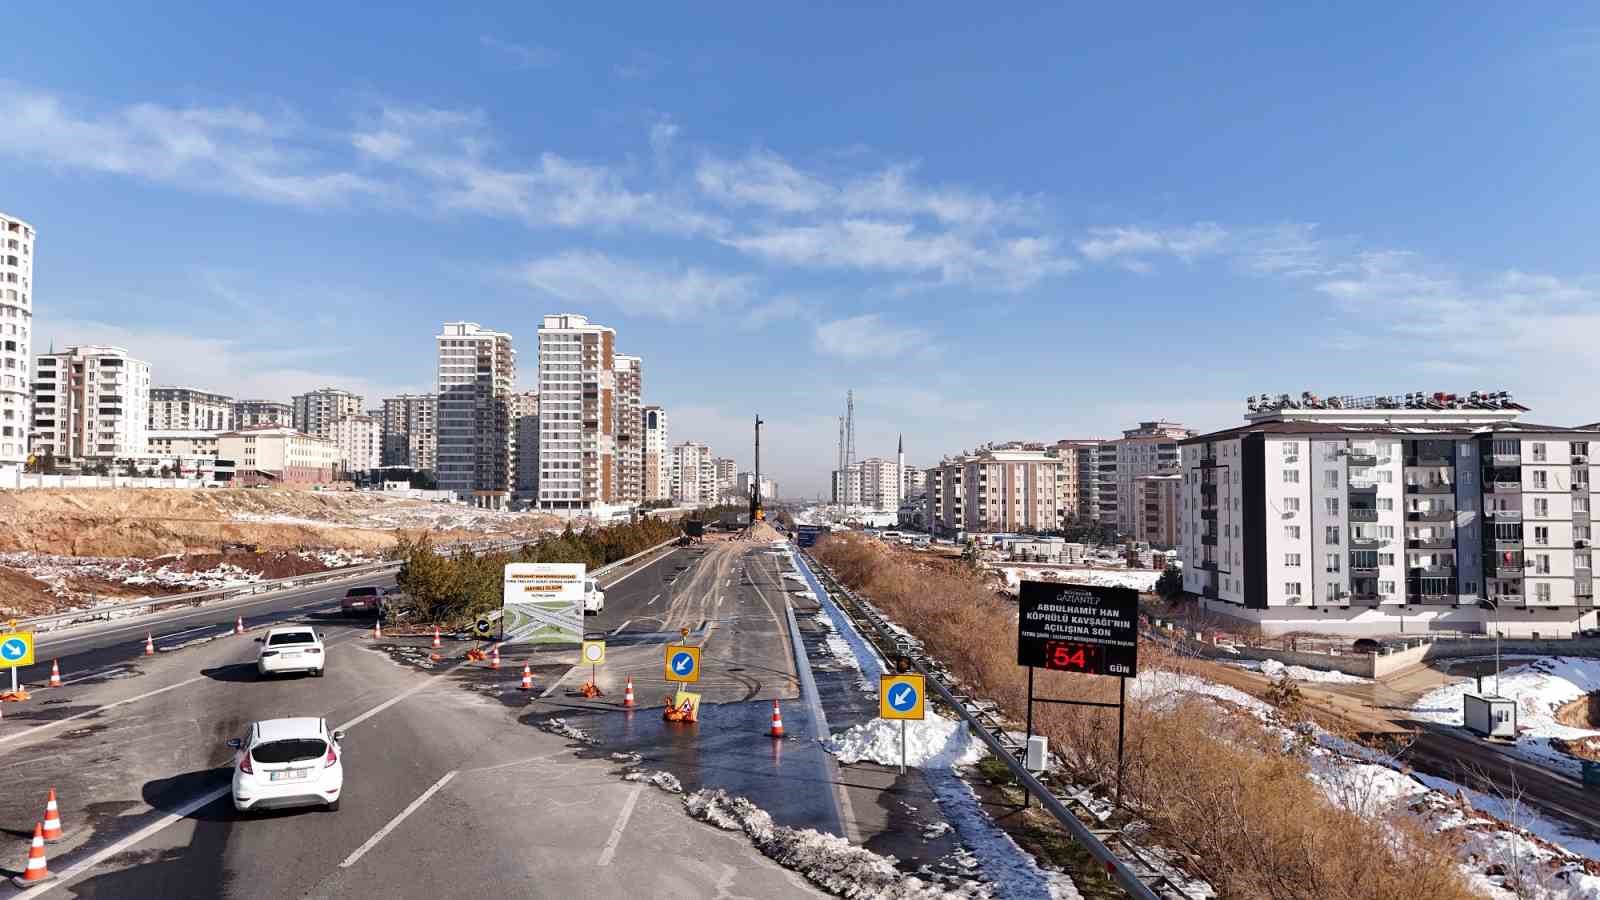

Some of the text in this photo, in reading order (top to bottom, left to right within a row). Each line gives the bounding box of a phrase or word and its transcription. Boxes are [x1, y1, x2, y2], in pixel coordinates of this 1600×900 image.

[1037, 603, 1120, 617] ABDULHAMİT HAN
[1026, 611, 1131, 629] KÖPRÜLÜ KAVŞAĞI'NIN
[1044, 623, 1111, 637] AÇILIŞINA SON
[1054, 647, 1086, 668] 54
[1109, 664, 1130, 674] GÜN
